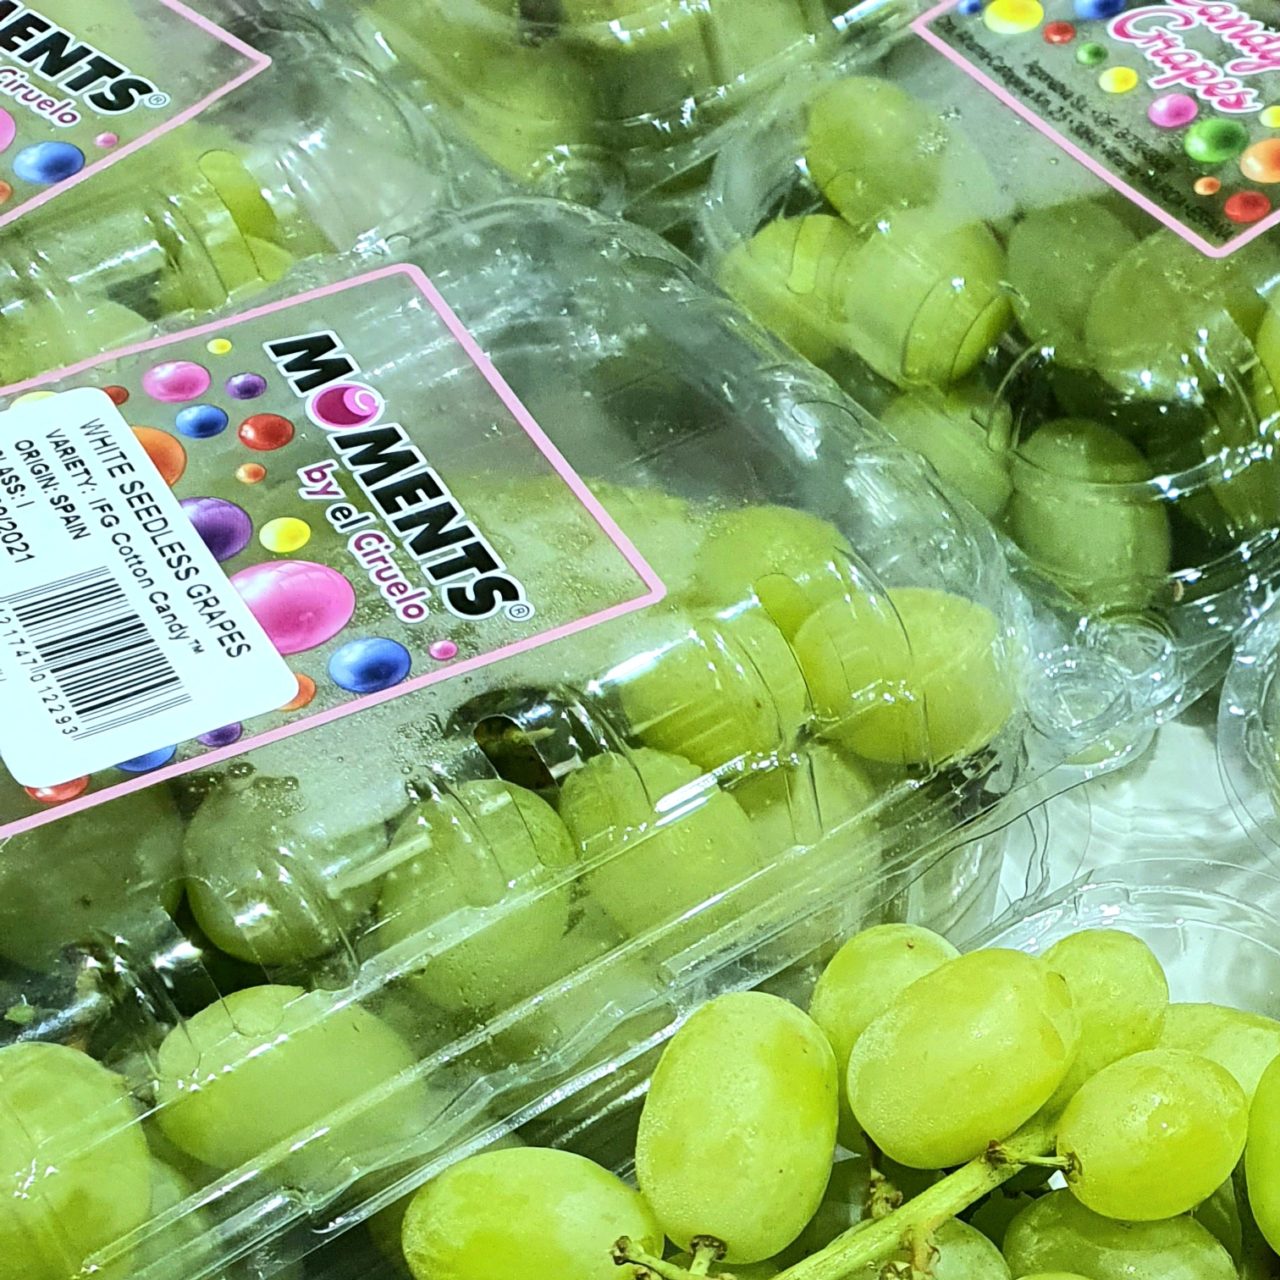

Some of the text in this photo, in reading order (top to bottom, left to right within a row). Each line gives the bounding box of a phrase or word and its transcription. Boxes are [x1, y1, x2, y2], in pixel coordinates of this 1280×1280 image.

[1113, 9, 1262, 111] Grapes
[0, 450, 26, 500] ASS:
[15, 439, 91, 540] ORIGIN: SPAIN
[46, 429, 97, 494] VARIETY:
[89, 498, 120, 528] IFG
[112, 532, 154, 588] Cotton
[80, 418, 251, 657] WHITE SEEDLESS GRAPES
[302, 463, 425, 618] by el Ciruelo
